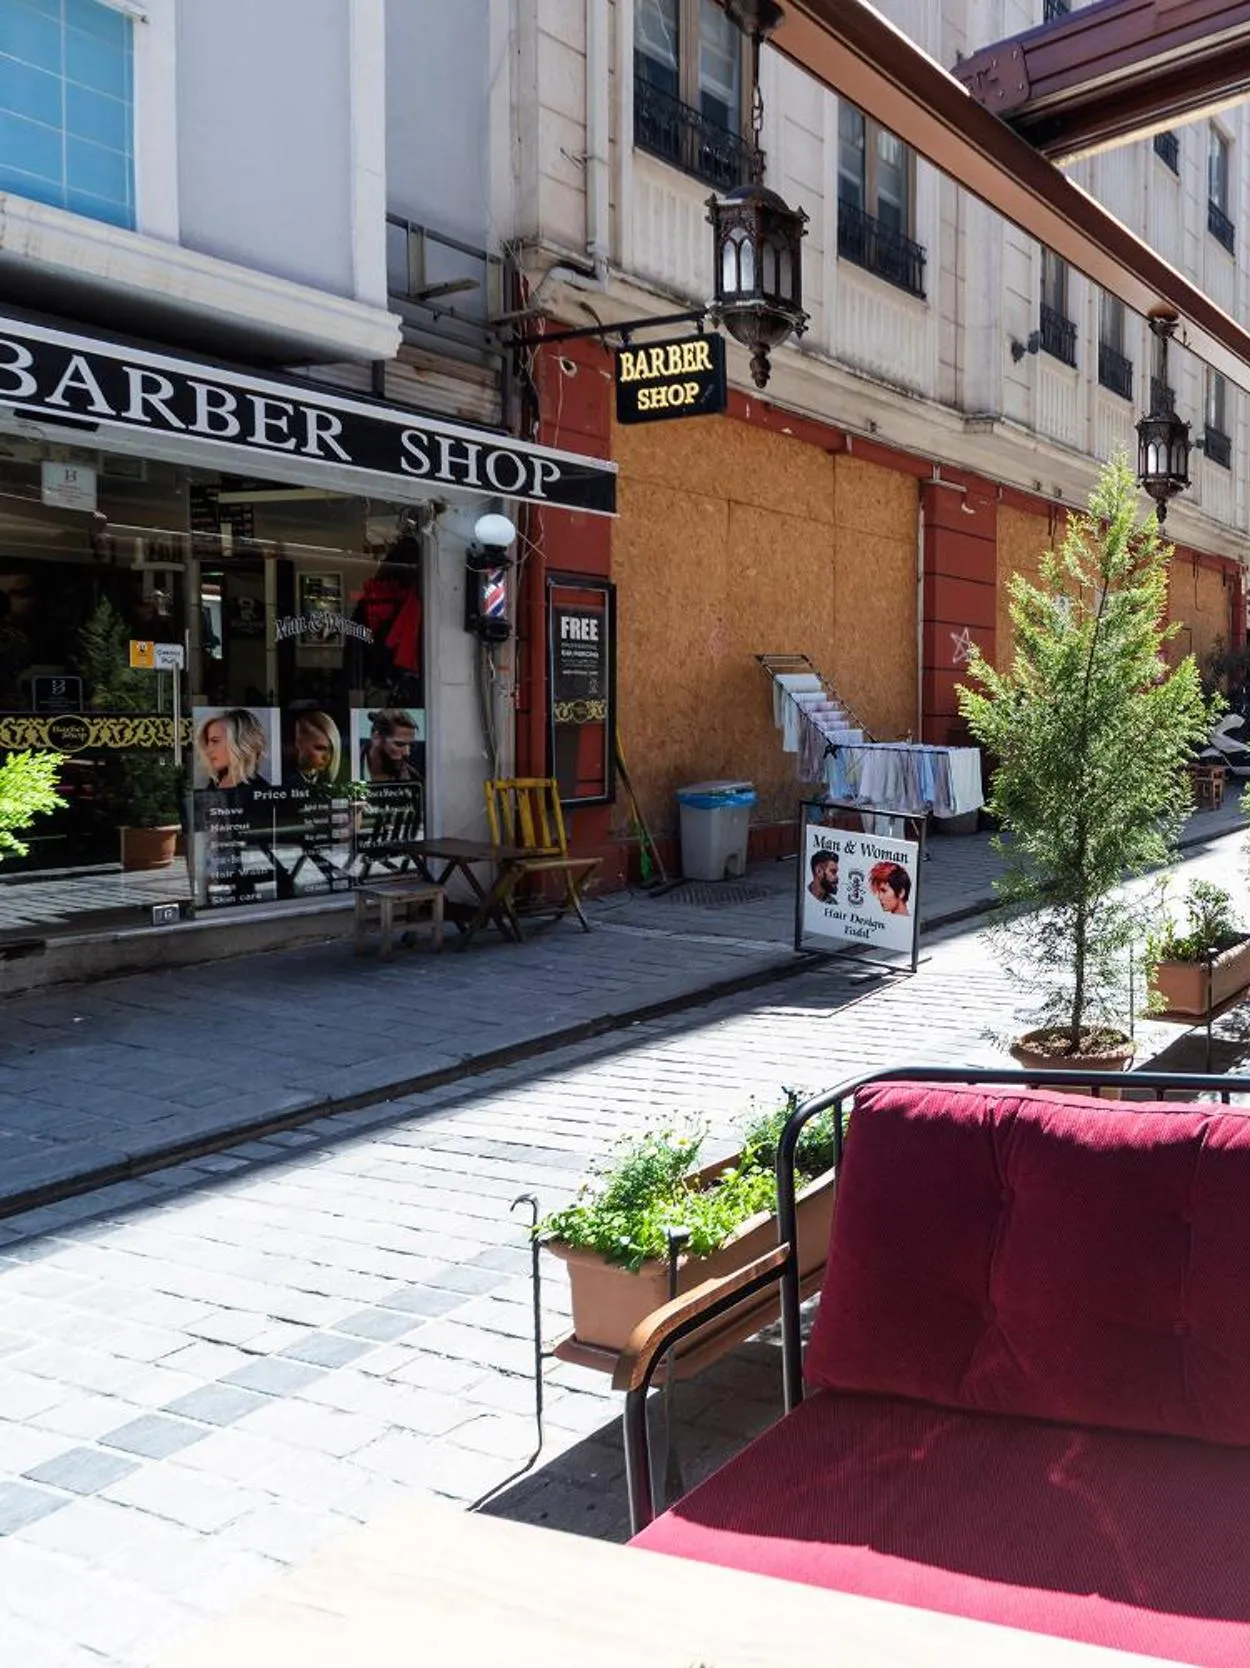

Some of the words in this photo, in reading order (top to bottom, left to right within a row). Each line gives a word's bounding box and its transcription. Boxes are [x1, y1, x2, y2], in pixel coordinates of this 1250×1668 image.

[619, 340, 713, 382] BARBER
[637, 382, 700, 410] SHOP
[0, 339, 352, 462] BARBER
[400, 429, 561, 498] SHOP
[561, 615, 599, 641] FREE
[253, 790, 288, 801] Price
[290, 788, 310, 799] list
[813, 834, 841, 852] Man
[844, 840, 858, 855] &
[860, 842, 909, 864] Woman
[824, 907, 848, 920] Hair
[850, 913, 886, 932] Design
